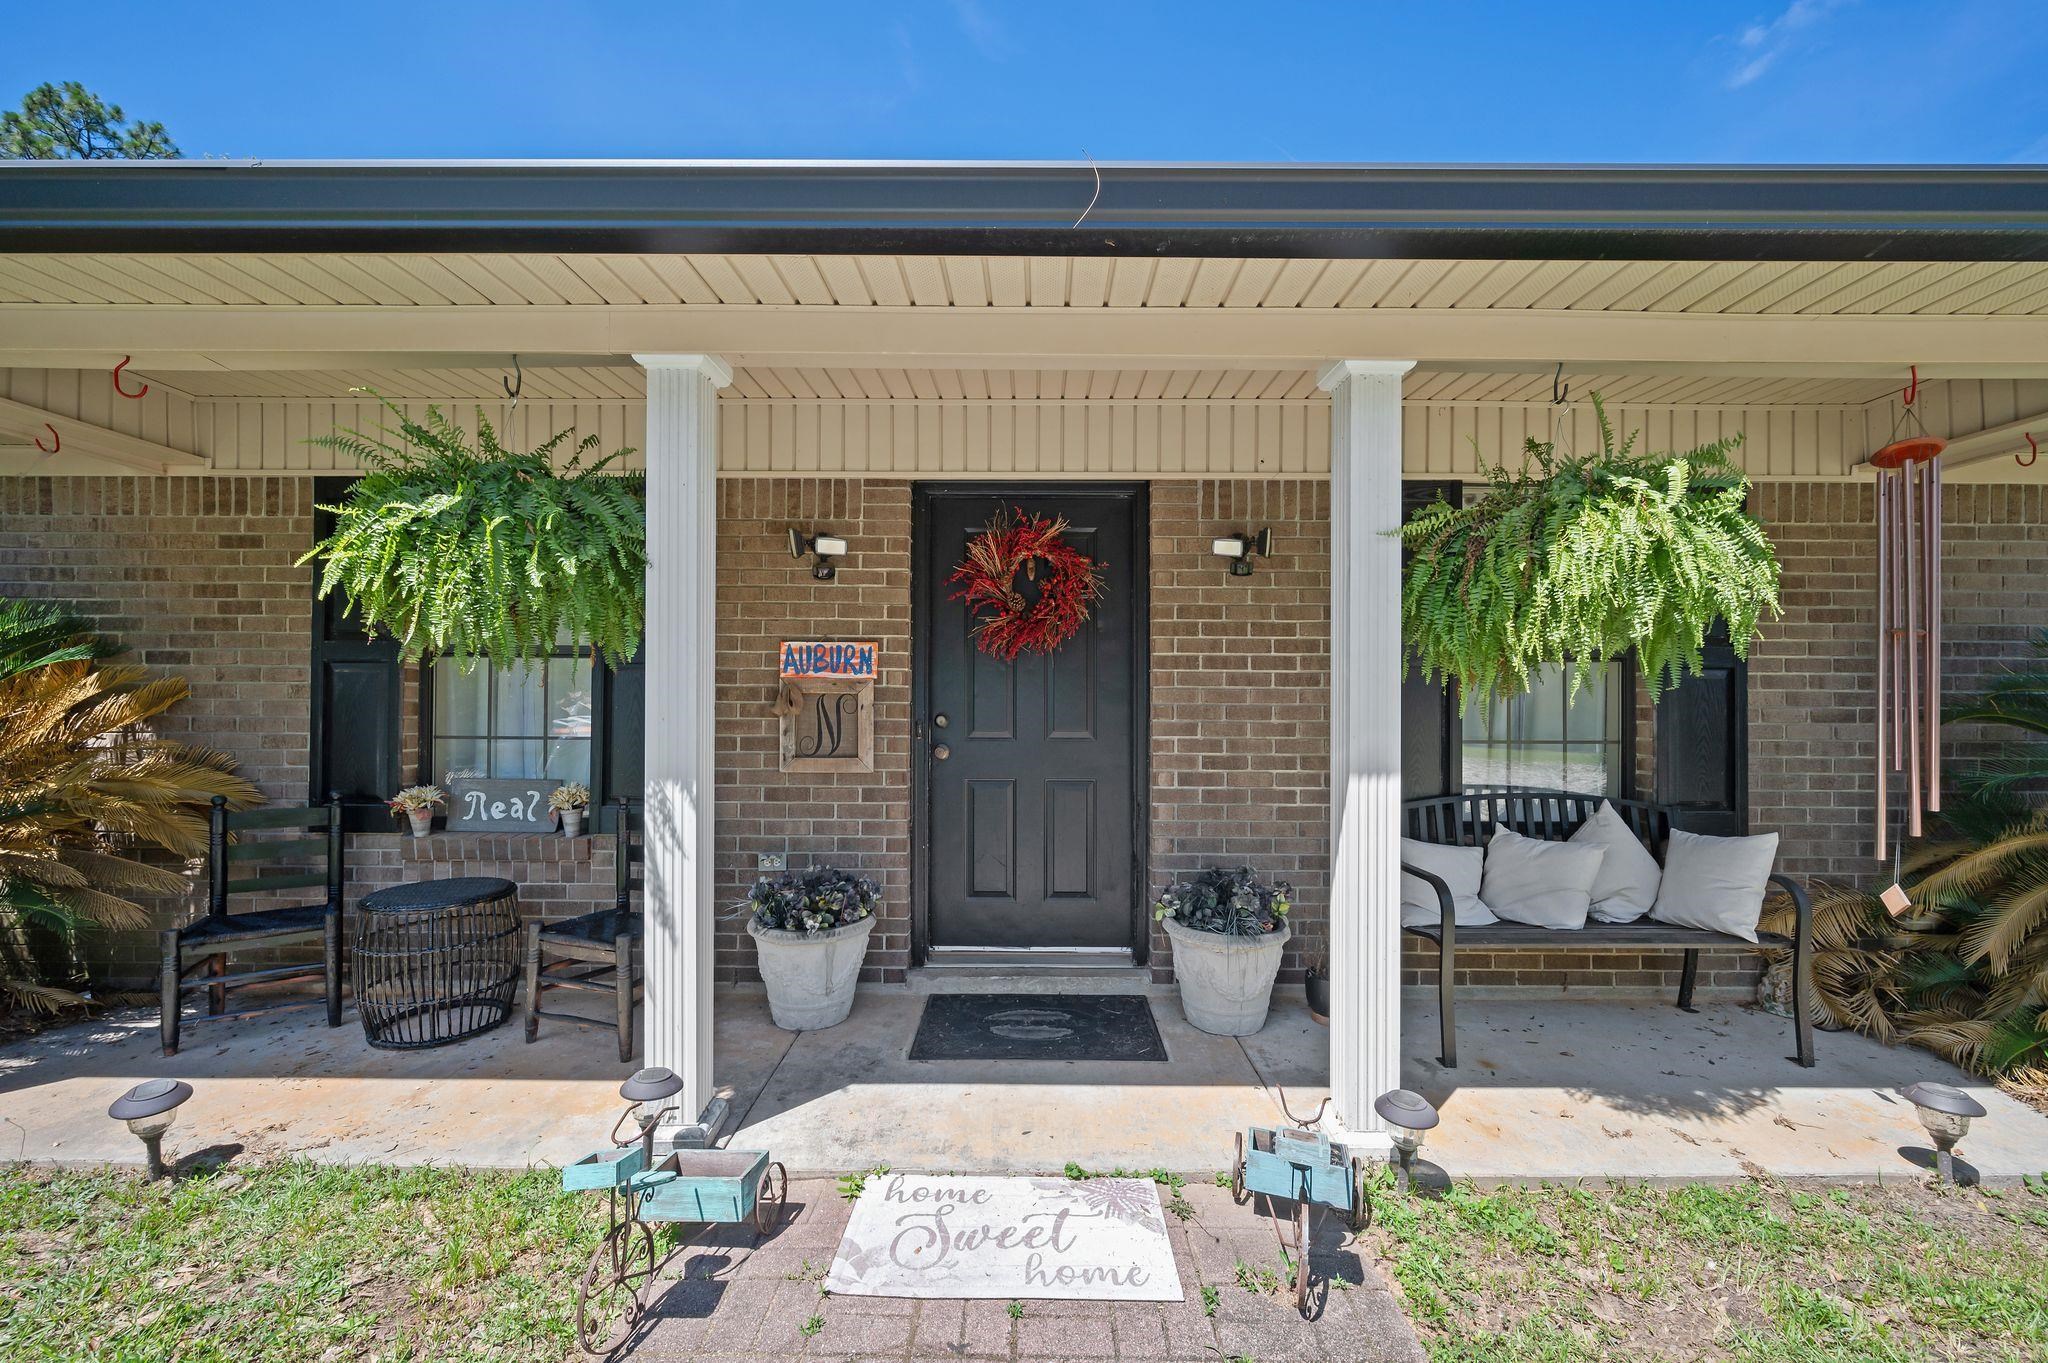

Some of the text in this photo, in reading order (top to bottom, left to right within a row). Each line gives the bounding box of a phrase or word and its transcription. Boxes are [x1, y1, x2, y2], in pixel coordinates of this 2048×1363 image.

[783, 643, 873, 675] AUBURN
[800, 693, 858, 757] N
[884, 1175, 993, 1205] home
[888, 1203, 1104, 1272] Sweet
[1023, 1252, 1151, 1288] home
